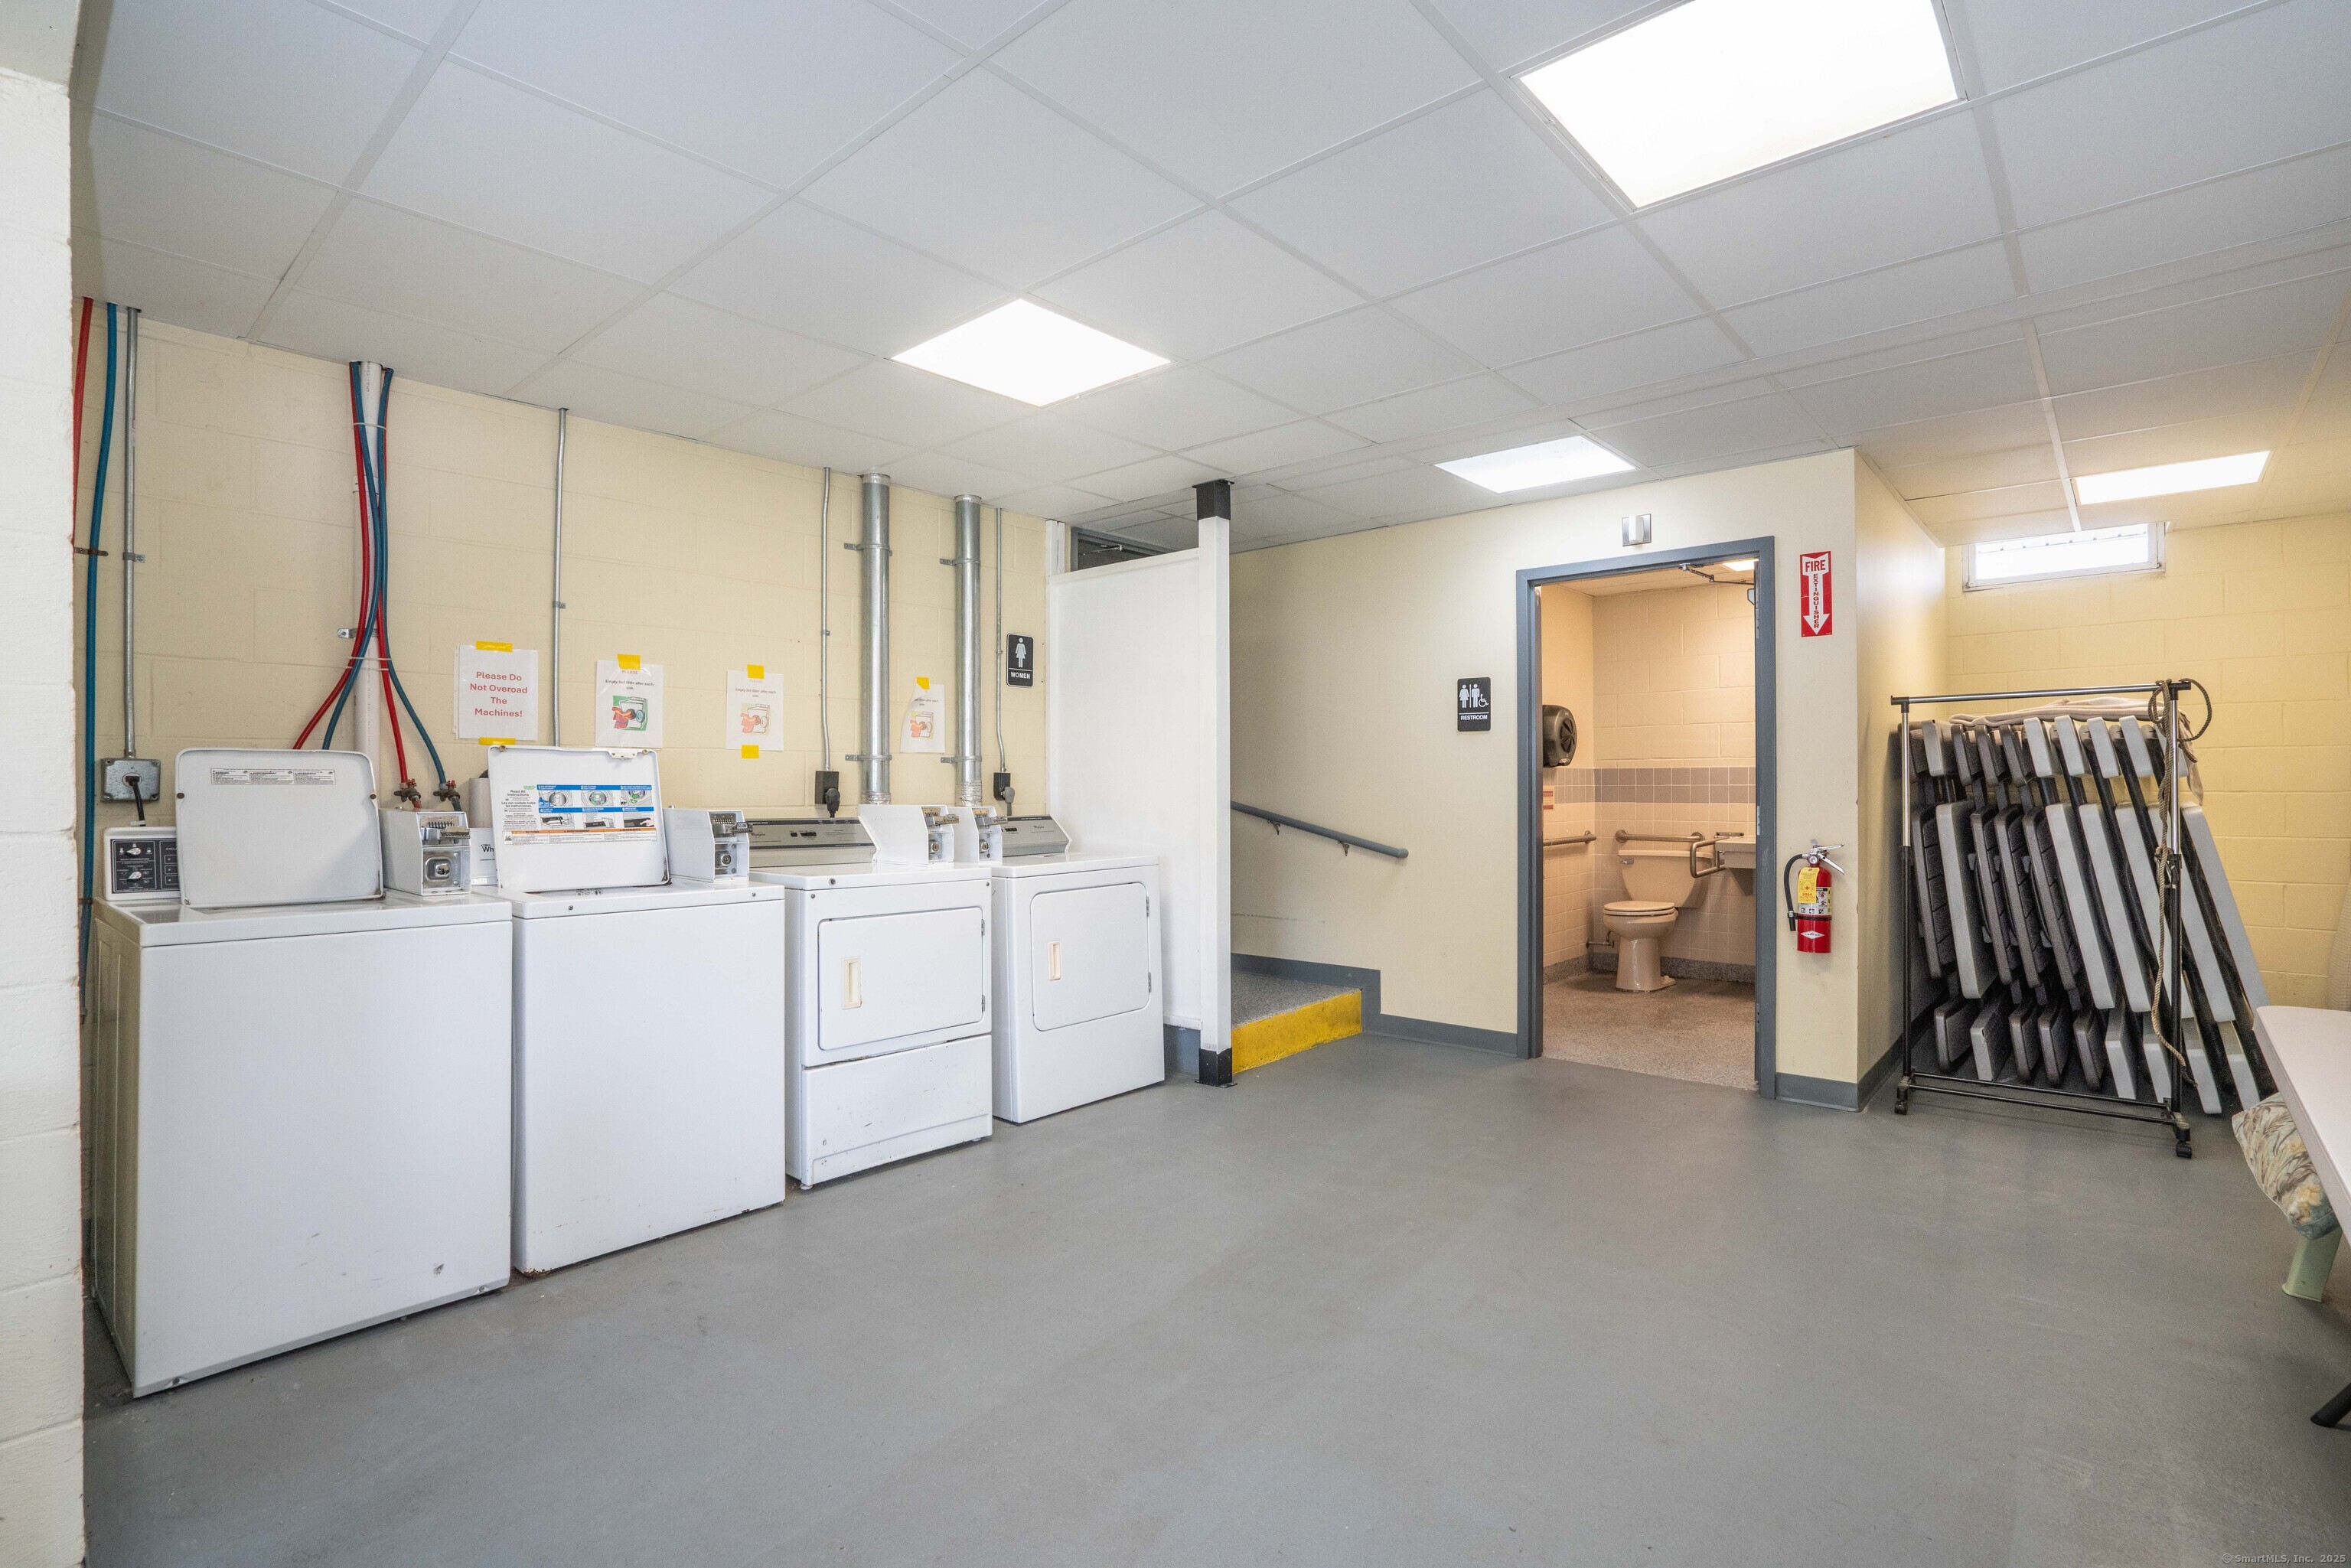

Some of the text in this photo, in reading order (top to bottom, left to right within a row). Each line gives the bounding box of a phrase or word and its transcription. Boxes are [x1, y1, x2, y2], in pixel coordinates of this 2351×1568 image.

[1805, 559, 1826, 572] FIRE
[476, 671, 507, 680] Please
[470, 683, 528, 693] Not Overoad
[491, 696, 507, 705] The
[474, 708, 523, 718] Machines!
